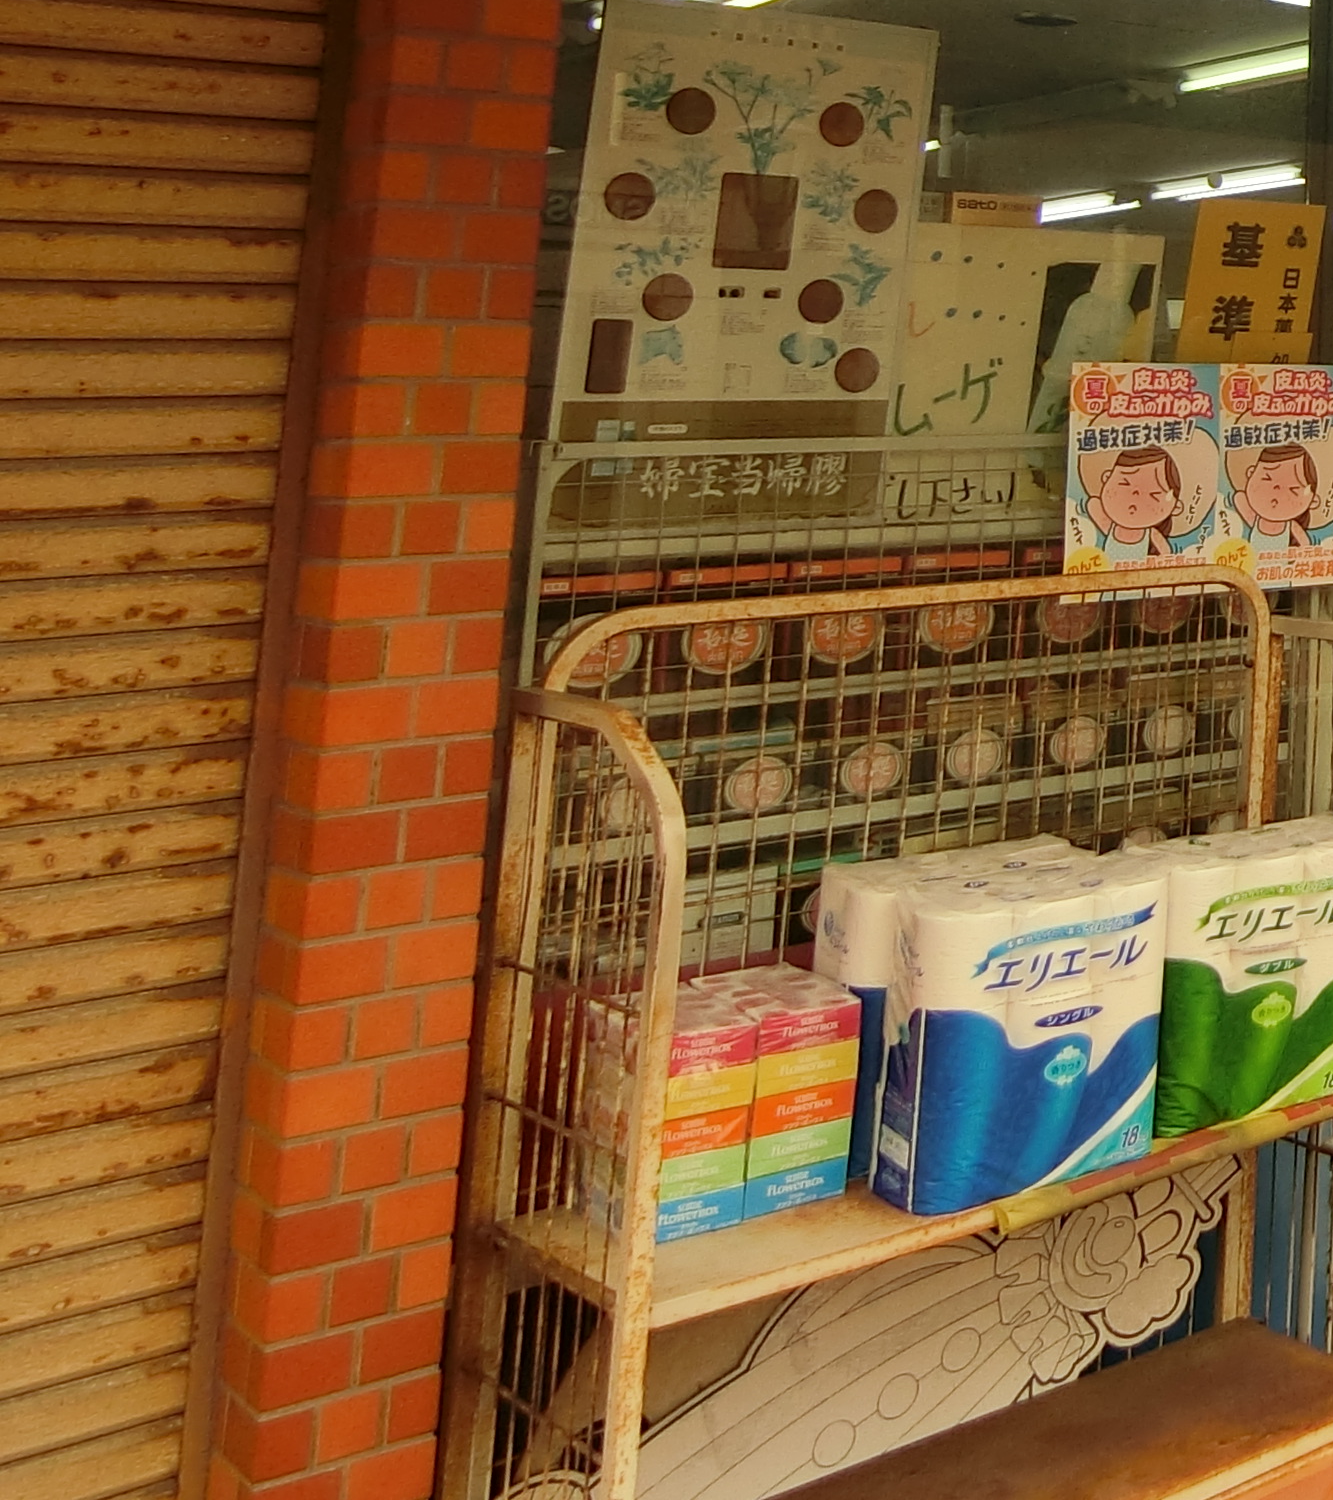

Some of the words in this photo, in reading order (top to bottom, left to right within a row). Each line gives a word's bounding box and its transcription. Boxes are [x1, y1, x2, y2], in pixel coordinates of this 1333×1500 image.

[885, 471, 1016, 522] し下さい!
[983, 934, 1150, 993] エリエール
[1046, 1006, 1096, 1029] シングル
[1120, 1124, 1141, 1148] 18
